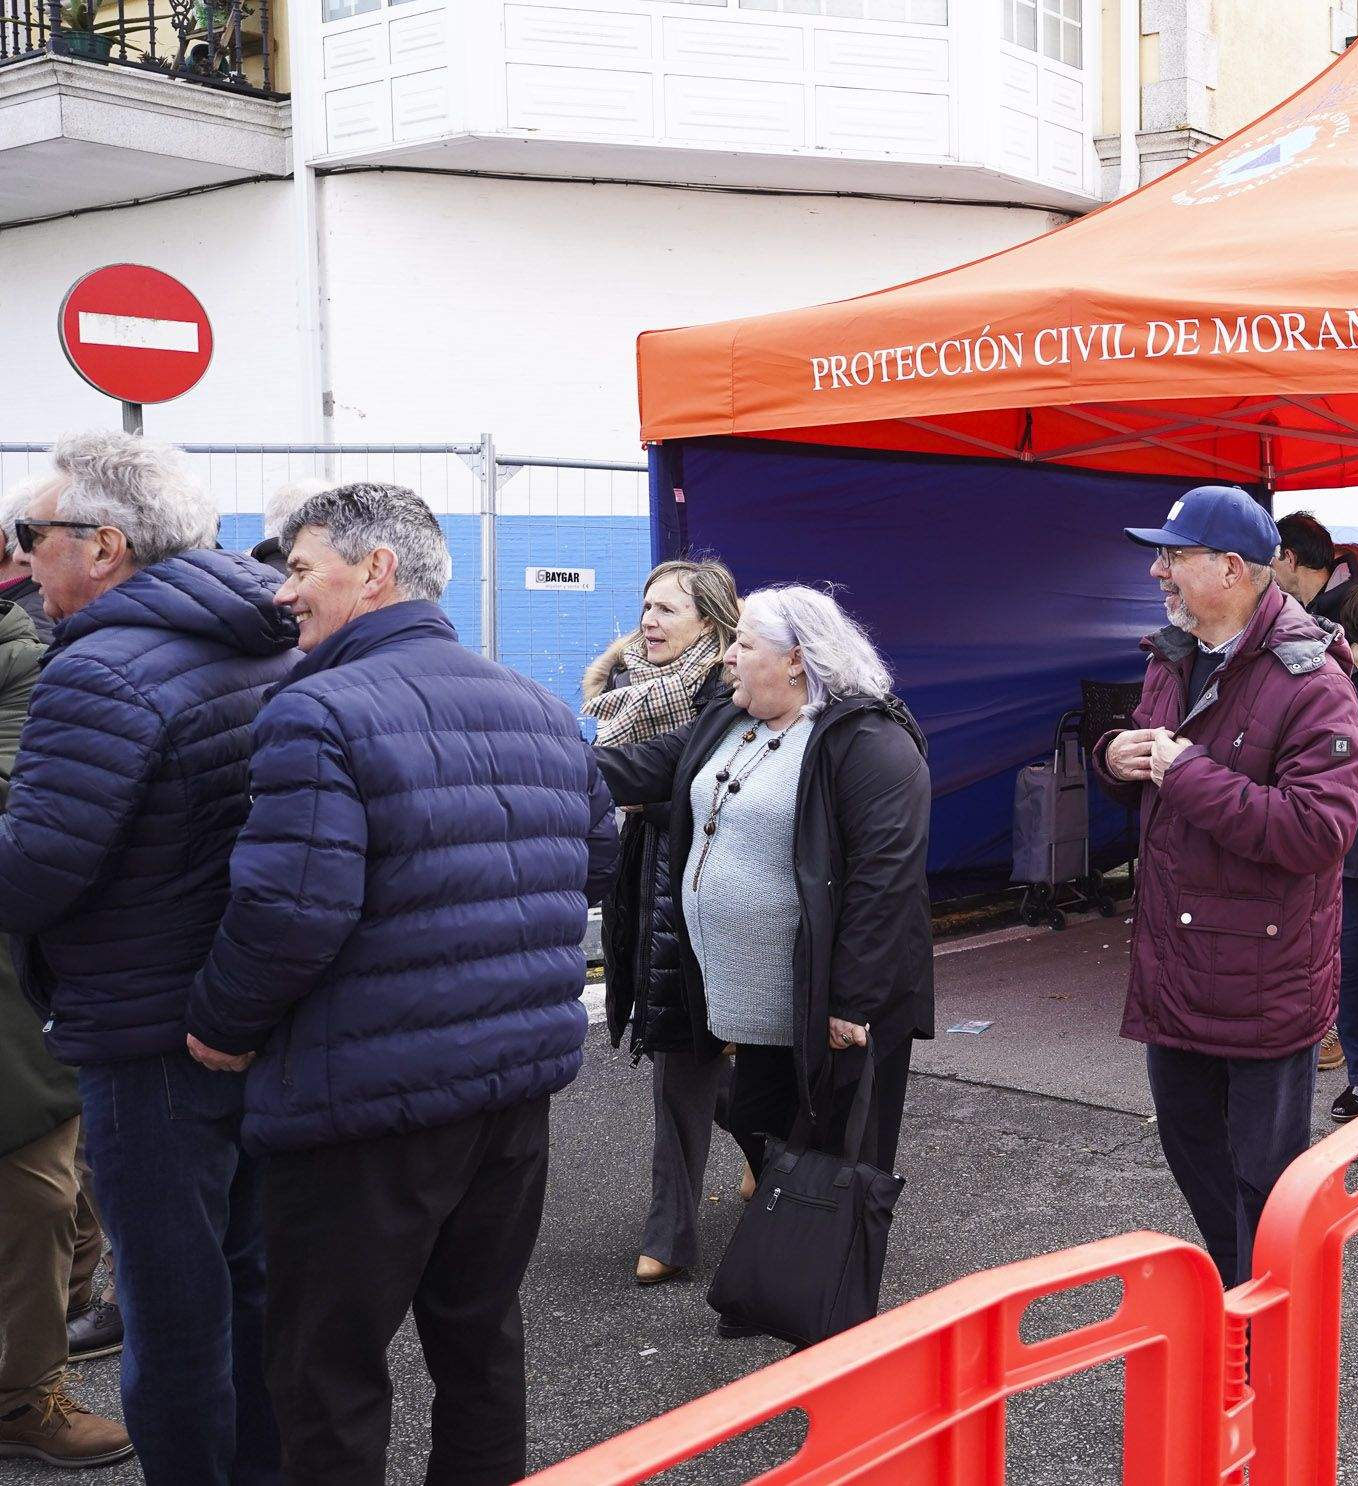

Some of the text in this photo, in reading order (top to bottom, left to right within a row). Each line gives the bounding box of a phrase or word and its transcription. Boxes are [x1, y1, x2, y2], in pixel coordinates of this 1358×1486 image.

[811, 324, 1024, 391] PROTECCIÓN
[1034, 322, 1136, 366] CIVIL
[1145, 318, 1200, 358] DE
[546, 571, 580, 583] BAYGAR
